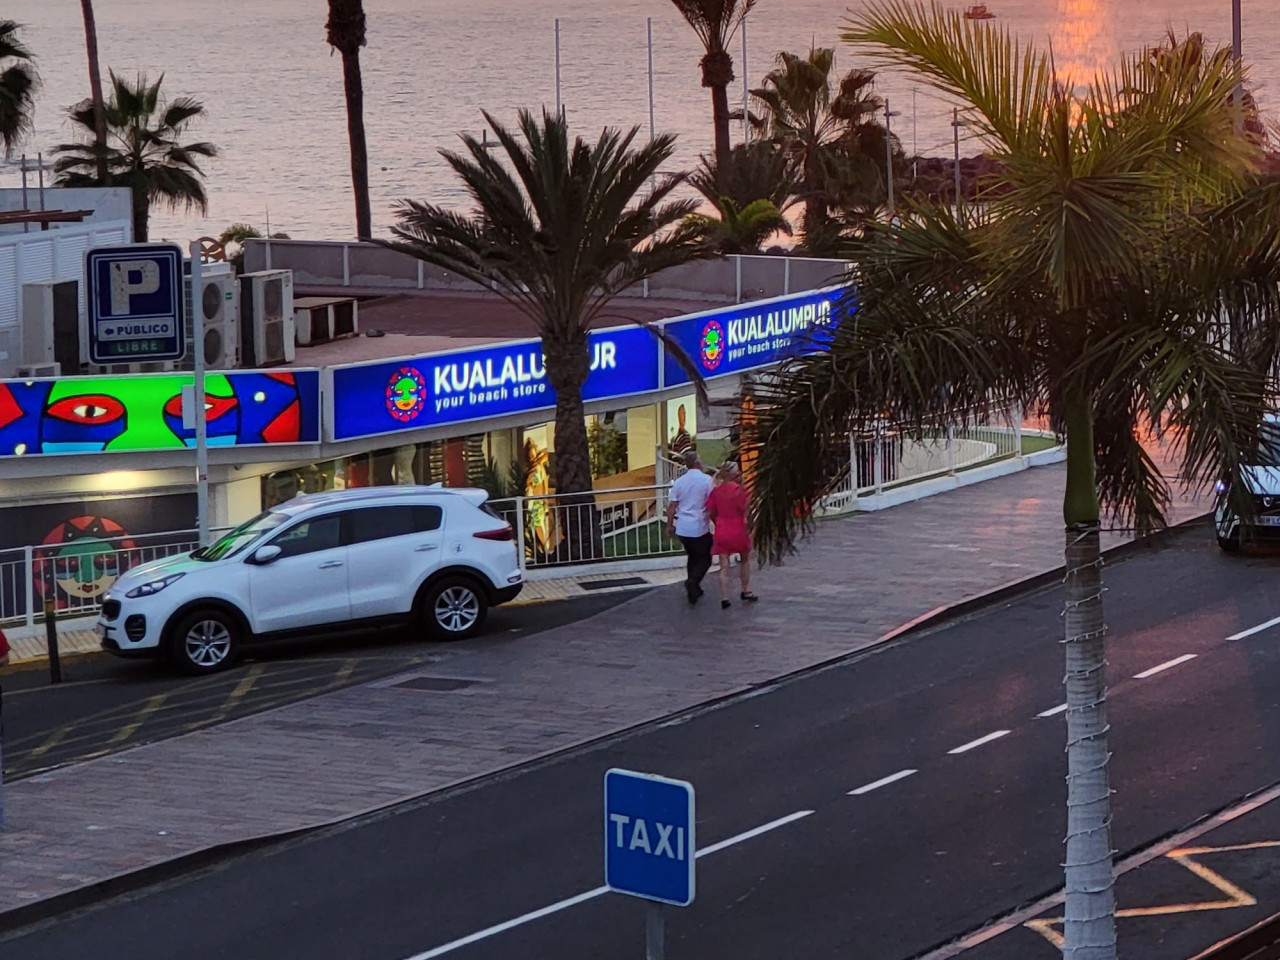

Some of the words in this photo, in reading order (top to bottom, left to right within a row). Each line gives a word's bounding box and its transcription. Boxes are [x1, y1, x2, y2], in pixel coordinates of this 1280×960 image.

[109, 259, 160, 315] P
[116, 324, 169, 335] PÚBLICO
[117, 342, 158, 352] LIBRE
[728, 346, 745, 362] your
[748, 341, 770, 355] beach
[434, 341, 616, 395] KUALALUUR
[435, 394, 465, 413] your
[469, 387, 508, 404] beach
[513, 383, 546, 396] store
[610, 813, 684, 861] TAXI
